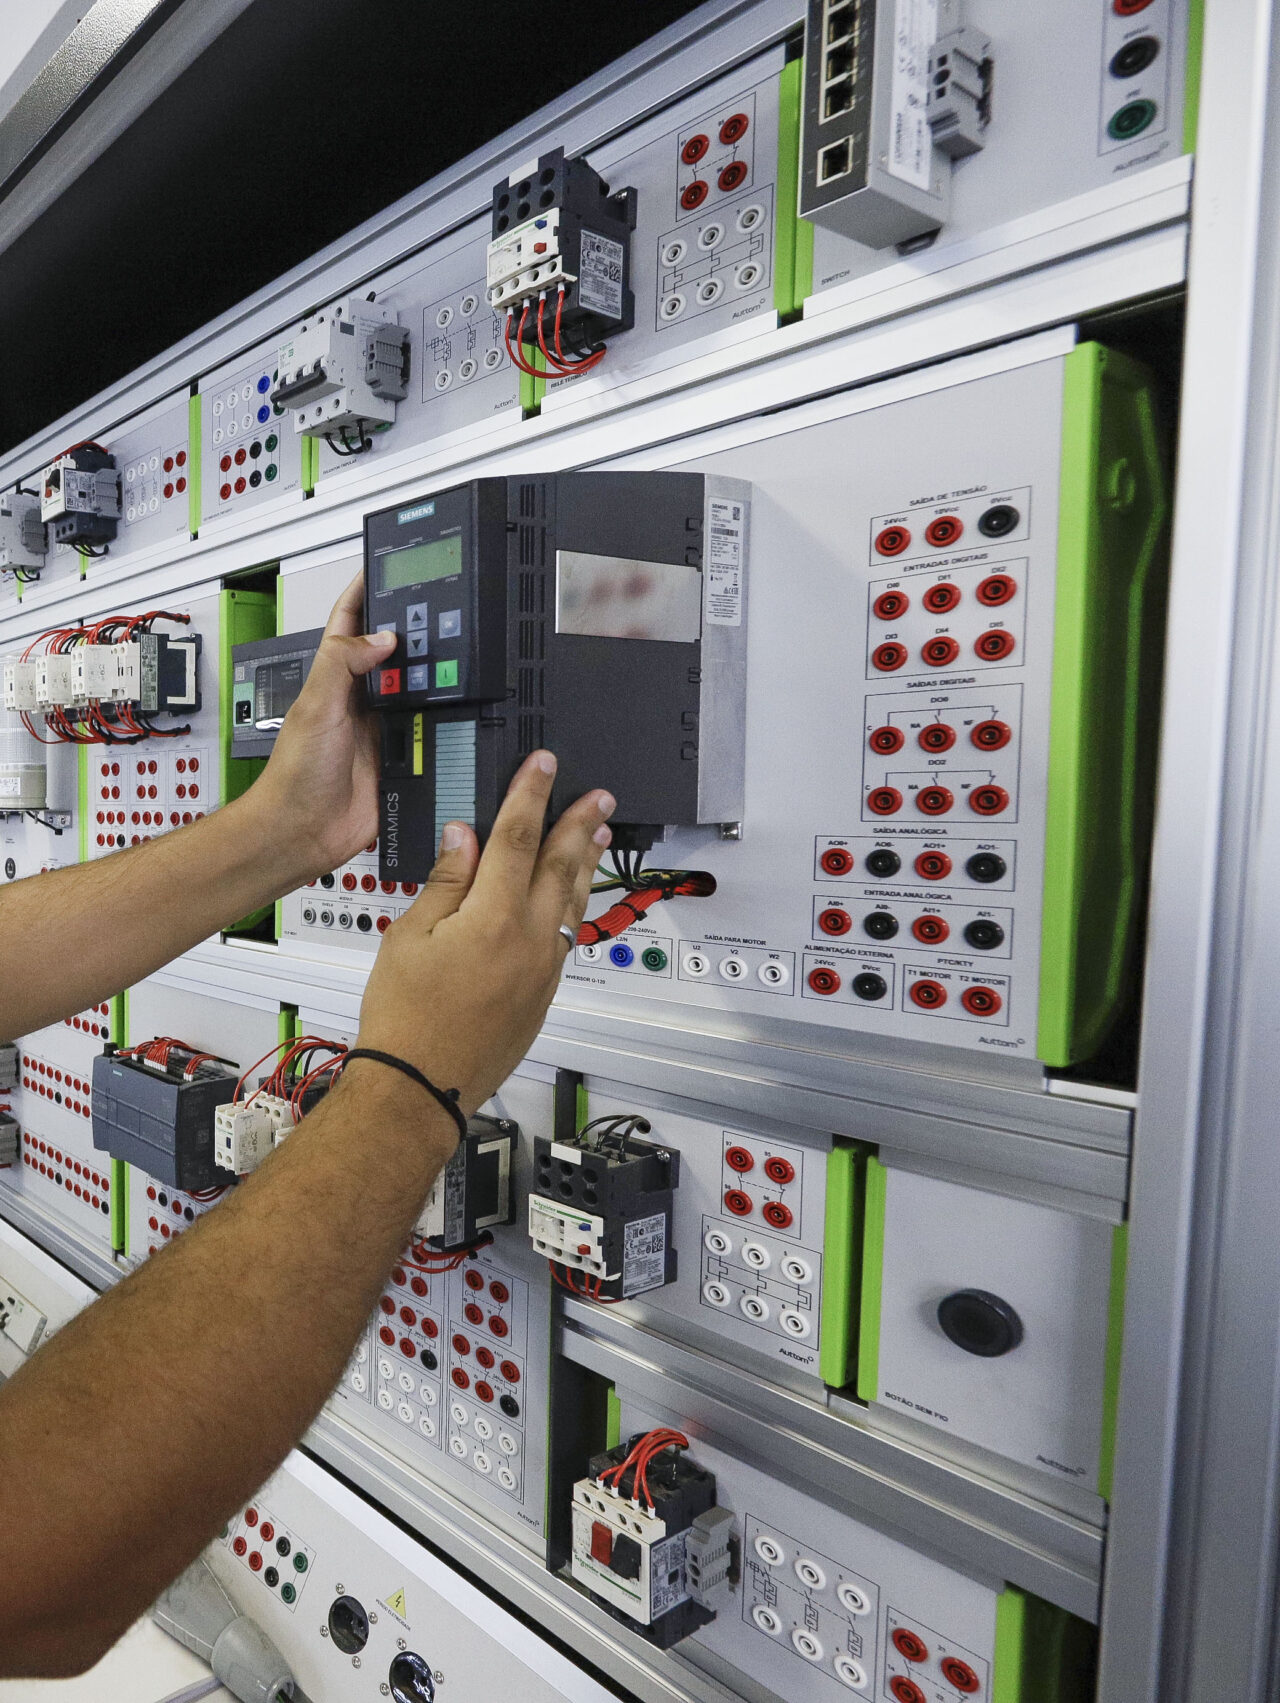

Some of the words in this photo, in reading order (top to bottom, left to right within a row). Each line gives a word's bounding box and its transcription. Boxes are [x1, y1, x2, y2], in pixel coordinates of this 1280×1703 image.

[821, 269, 850, 285] SWITCH
[909, 494, 935, 506] SAÍDA
[937, 493, 947, 501] DE
[951, 485, 988, 498] TENSÃO
[399, 505, 433, 521] SIEMENS
[903, 559, 949, 572] ENTRADAS
[951, 553, 988, 565] DIGITAIS
[906, 680, 937, 689] SAÍDAS
[939, 677, 976, 686] DIGITAIS
[386, 792, 399, 867] SINAMICS
[872, 826, 898, 835] SAÍDA
[899, 827, 948, 835] ANALÓGICA
[864, 889, 901, 898] ENTRADA
[902, 891, 952, 900] ANALÓGICA
[704, 934, 722, 942] SAÍDA
[724, 936, 741, 944] PARA
[742, 938, 766, 946] MOTOR
[804, 944, 856, 955] ALIMENTAÇÃO
[857, 949, 894, 959] EXTERNA
[919, 971, 951, 980] MOTOR
[971, 977, 1006, 986] MOTOR
[533, 1199, 557, 1212] Schneider
[779, 1348, 810, 1365] Auttom
[884, 1391, 913, 1407] BOTÃO
[915, 1404, 933, 1416] SEM
[934, 1411, 949, 1422] FIO
